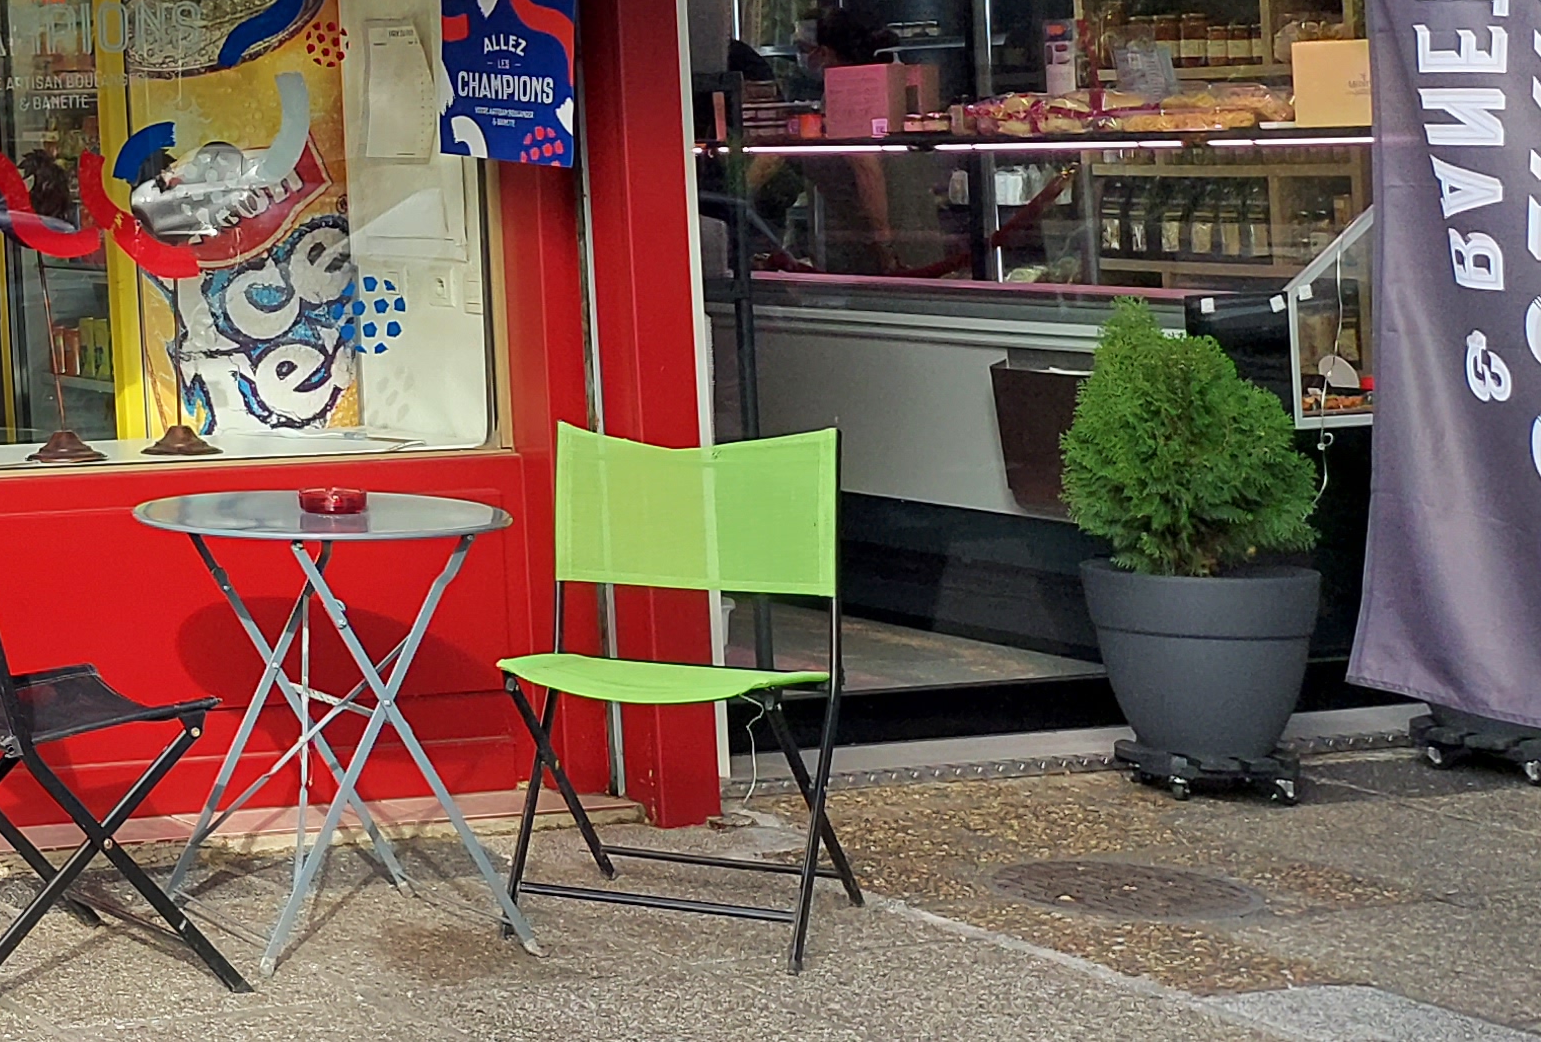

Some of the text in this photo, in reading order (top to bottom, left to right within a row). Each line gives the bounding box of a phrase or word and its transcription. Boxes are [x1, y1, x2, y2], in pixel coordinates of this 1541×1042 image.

[483, 33, 527, 56] ALLEZ
[5, 73, 64, 91] ARTISAN
[457, 70, 554, 104] CHAMPIONS
[32, 94, 90, 110] BANETTE
